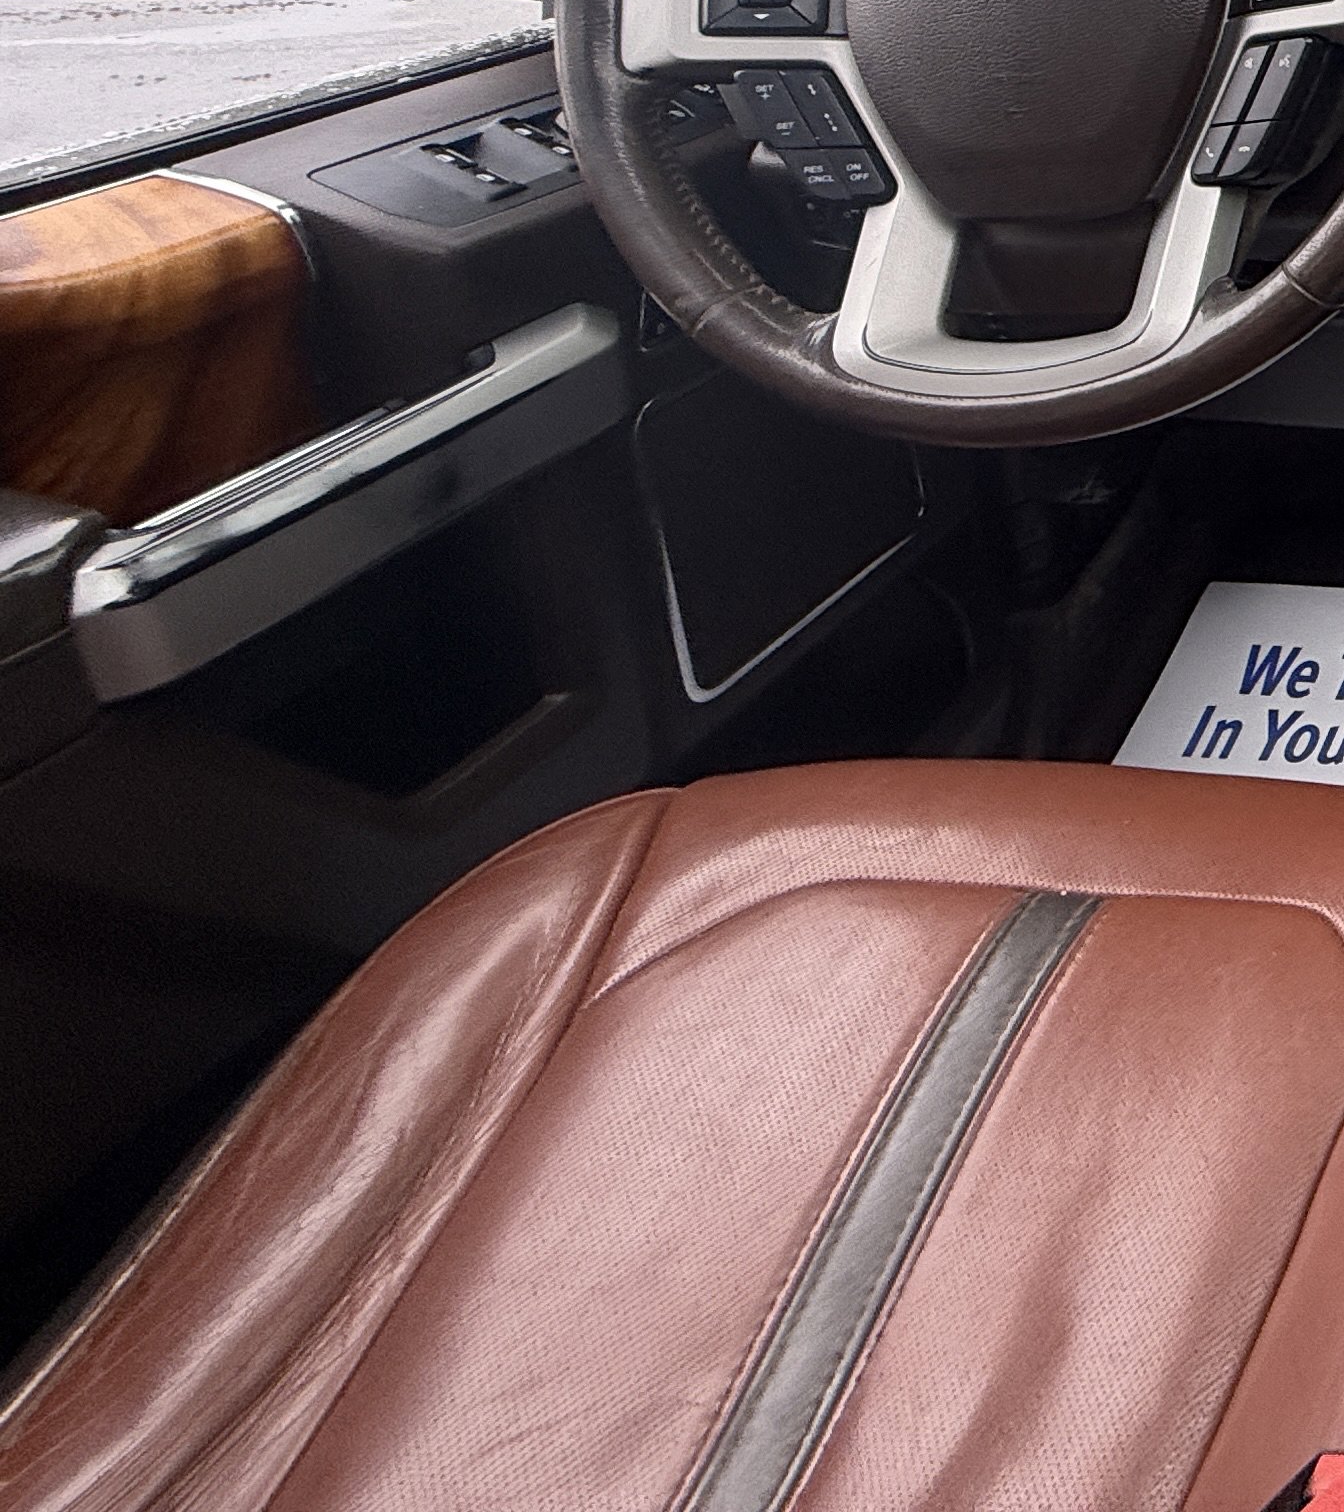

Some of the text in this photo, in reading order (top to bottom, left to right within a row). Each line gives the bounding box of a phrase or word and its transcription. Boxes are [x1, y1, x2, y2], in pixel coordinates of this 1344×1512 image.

[755, 83, 774, 94] SET
[775, 121, 795, 131] SET
[803, 164, 824, 174] RES
[846, 162, 862, 172] ON
[807, 173, 835, 185] CNCL
[849, 172, 870, 182] OFF
[1238, 642, 1321, 700] We
[1181, 705, 1243, 761] In
